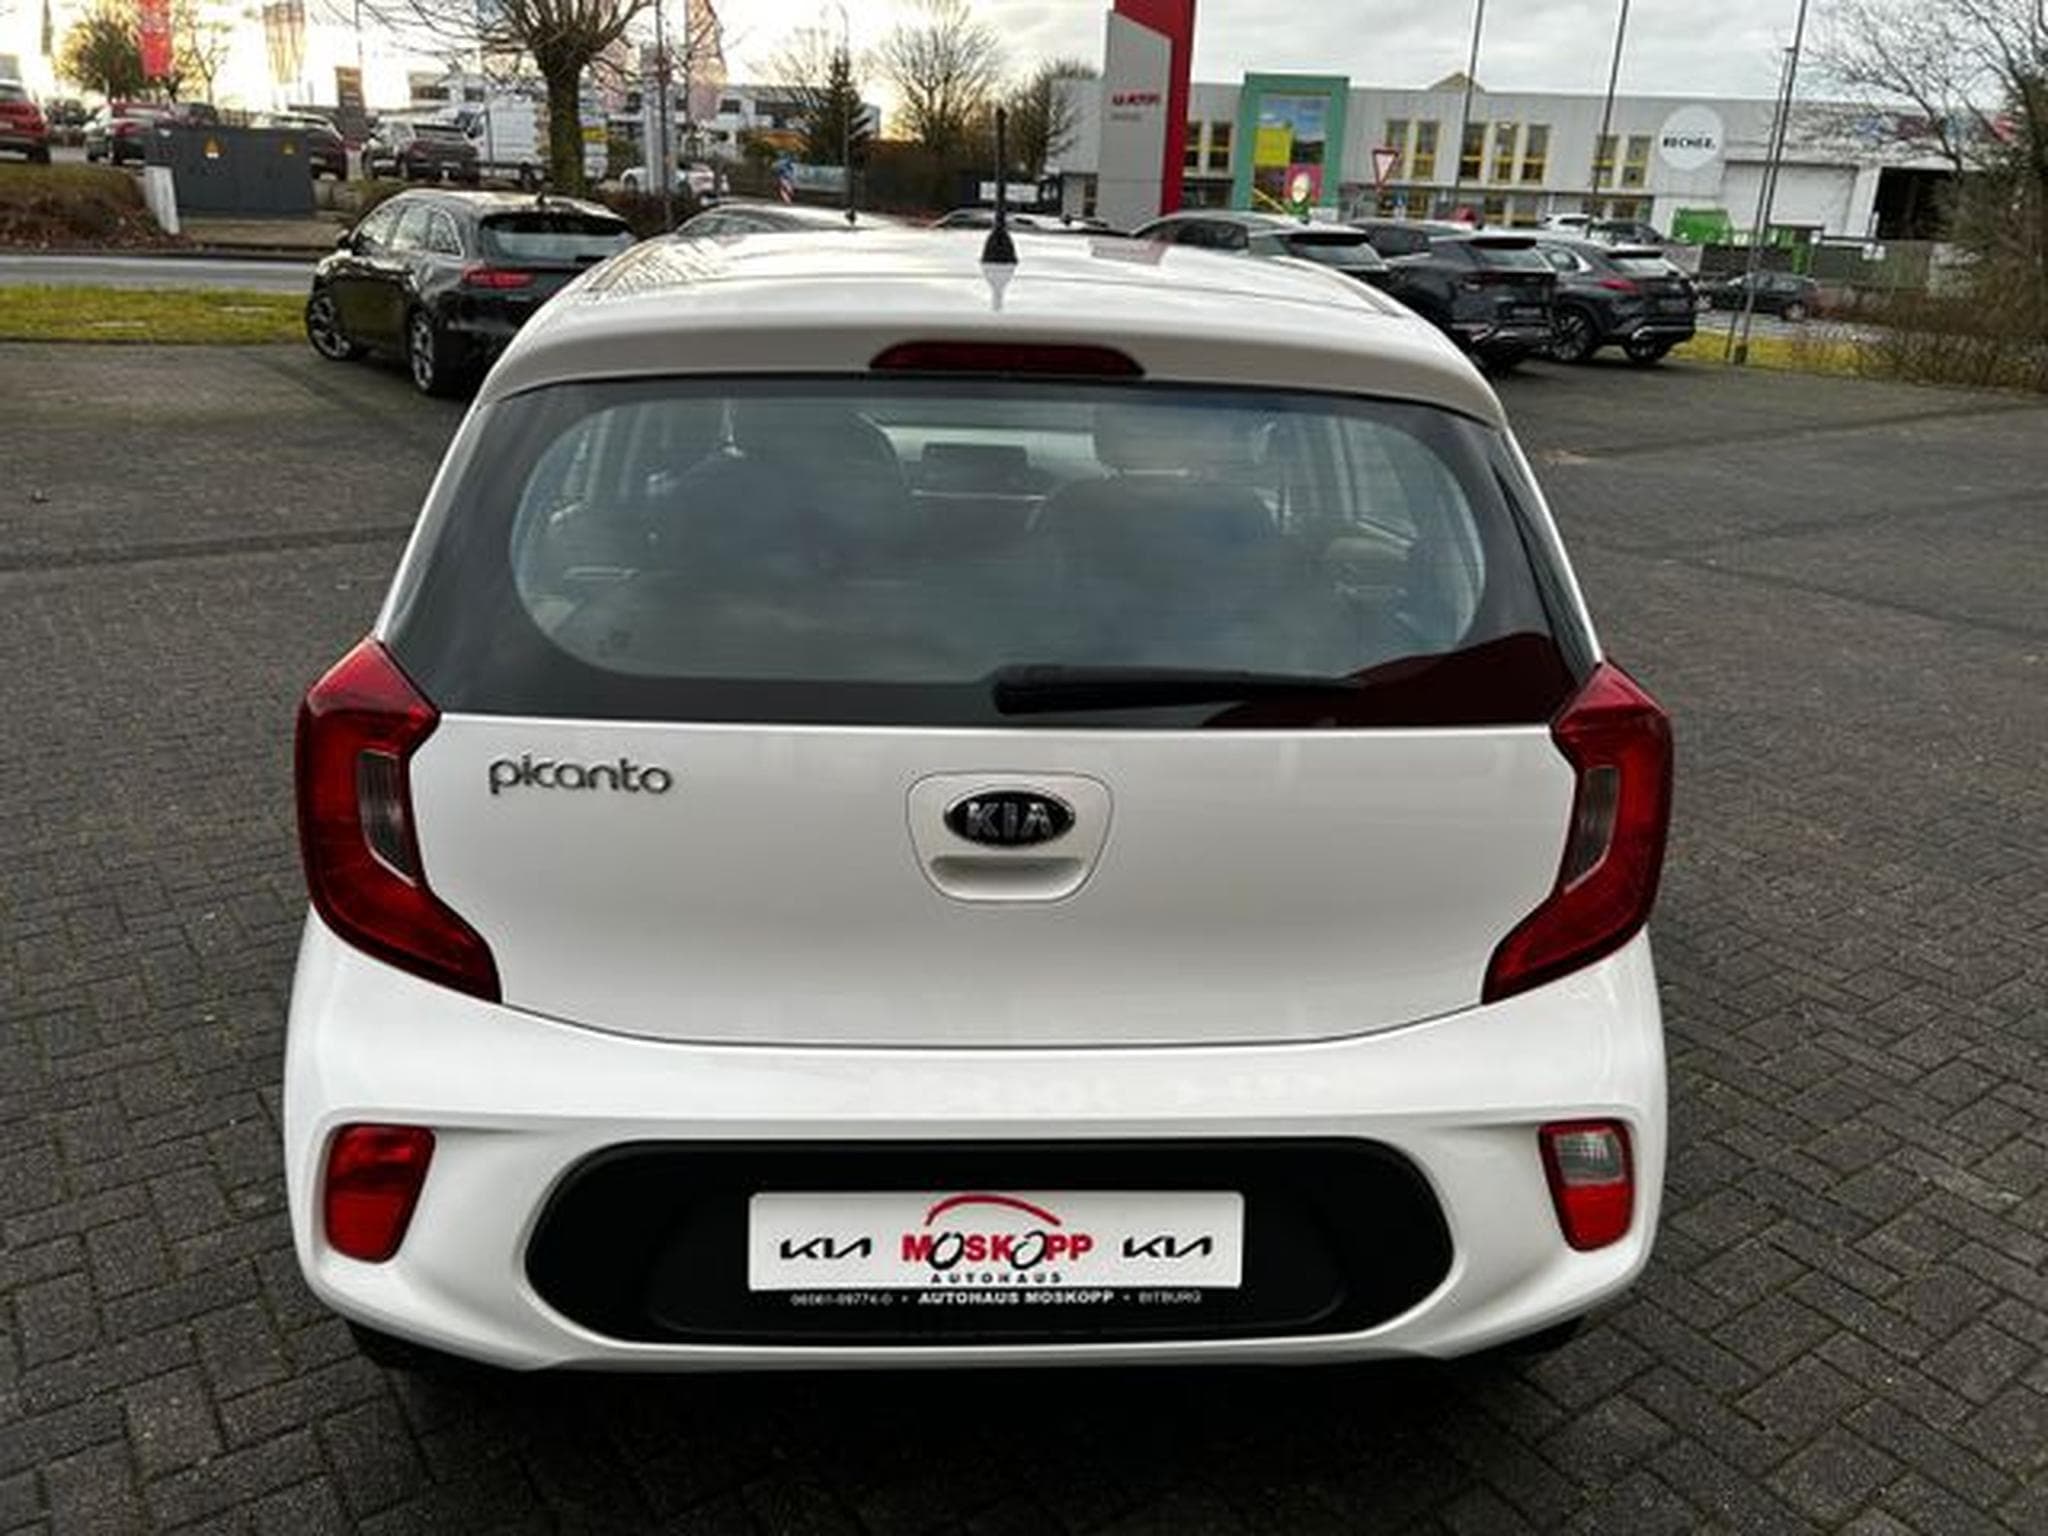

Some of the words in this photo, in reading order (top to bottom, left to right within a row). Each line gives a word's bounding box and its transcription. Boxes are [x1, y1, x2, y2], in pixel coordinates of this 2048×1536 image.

[489, 754, 673, 796] picanto
[966, 801, 1053, 838] KIA
[780, 1237, 872, 1260] KIA
[902, 1230, 1092, 1271] MOSKOPP
[1122, 1235, 1212, 1258] KIA
[931, 1273, 1062, 1284] AUTOHAUS
[918, 1291, 1019, 1305] AUTOHAUS
[1025, 1290, 1114, 1305] MOSKOPP
